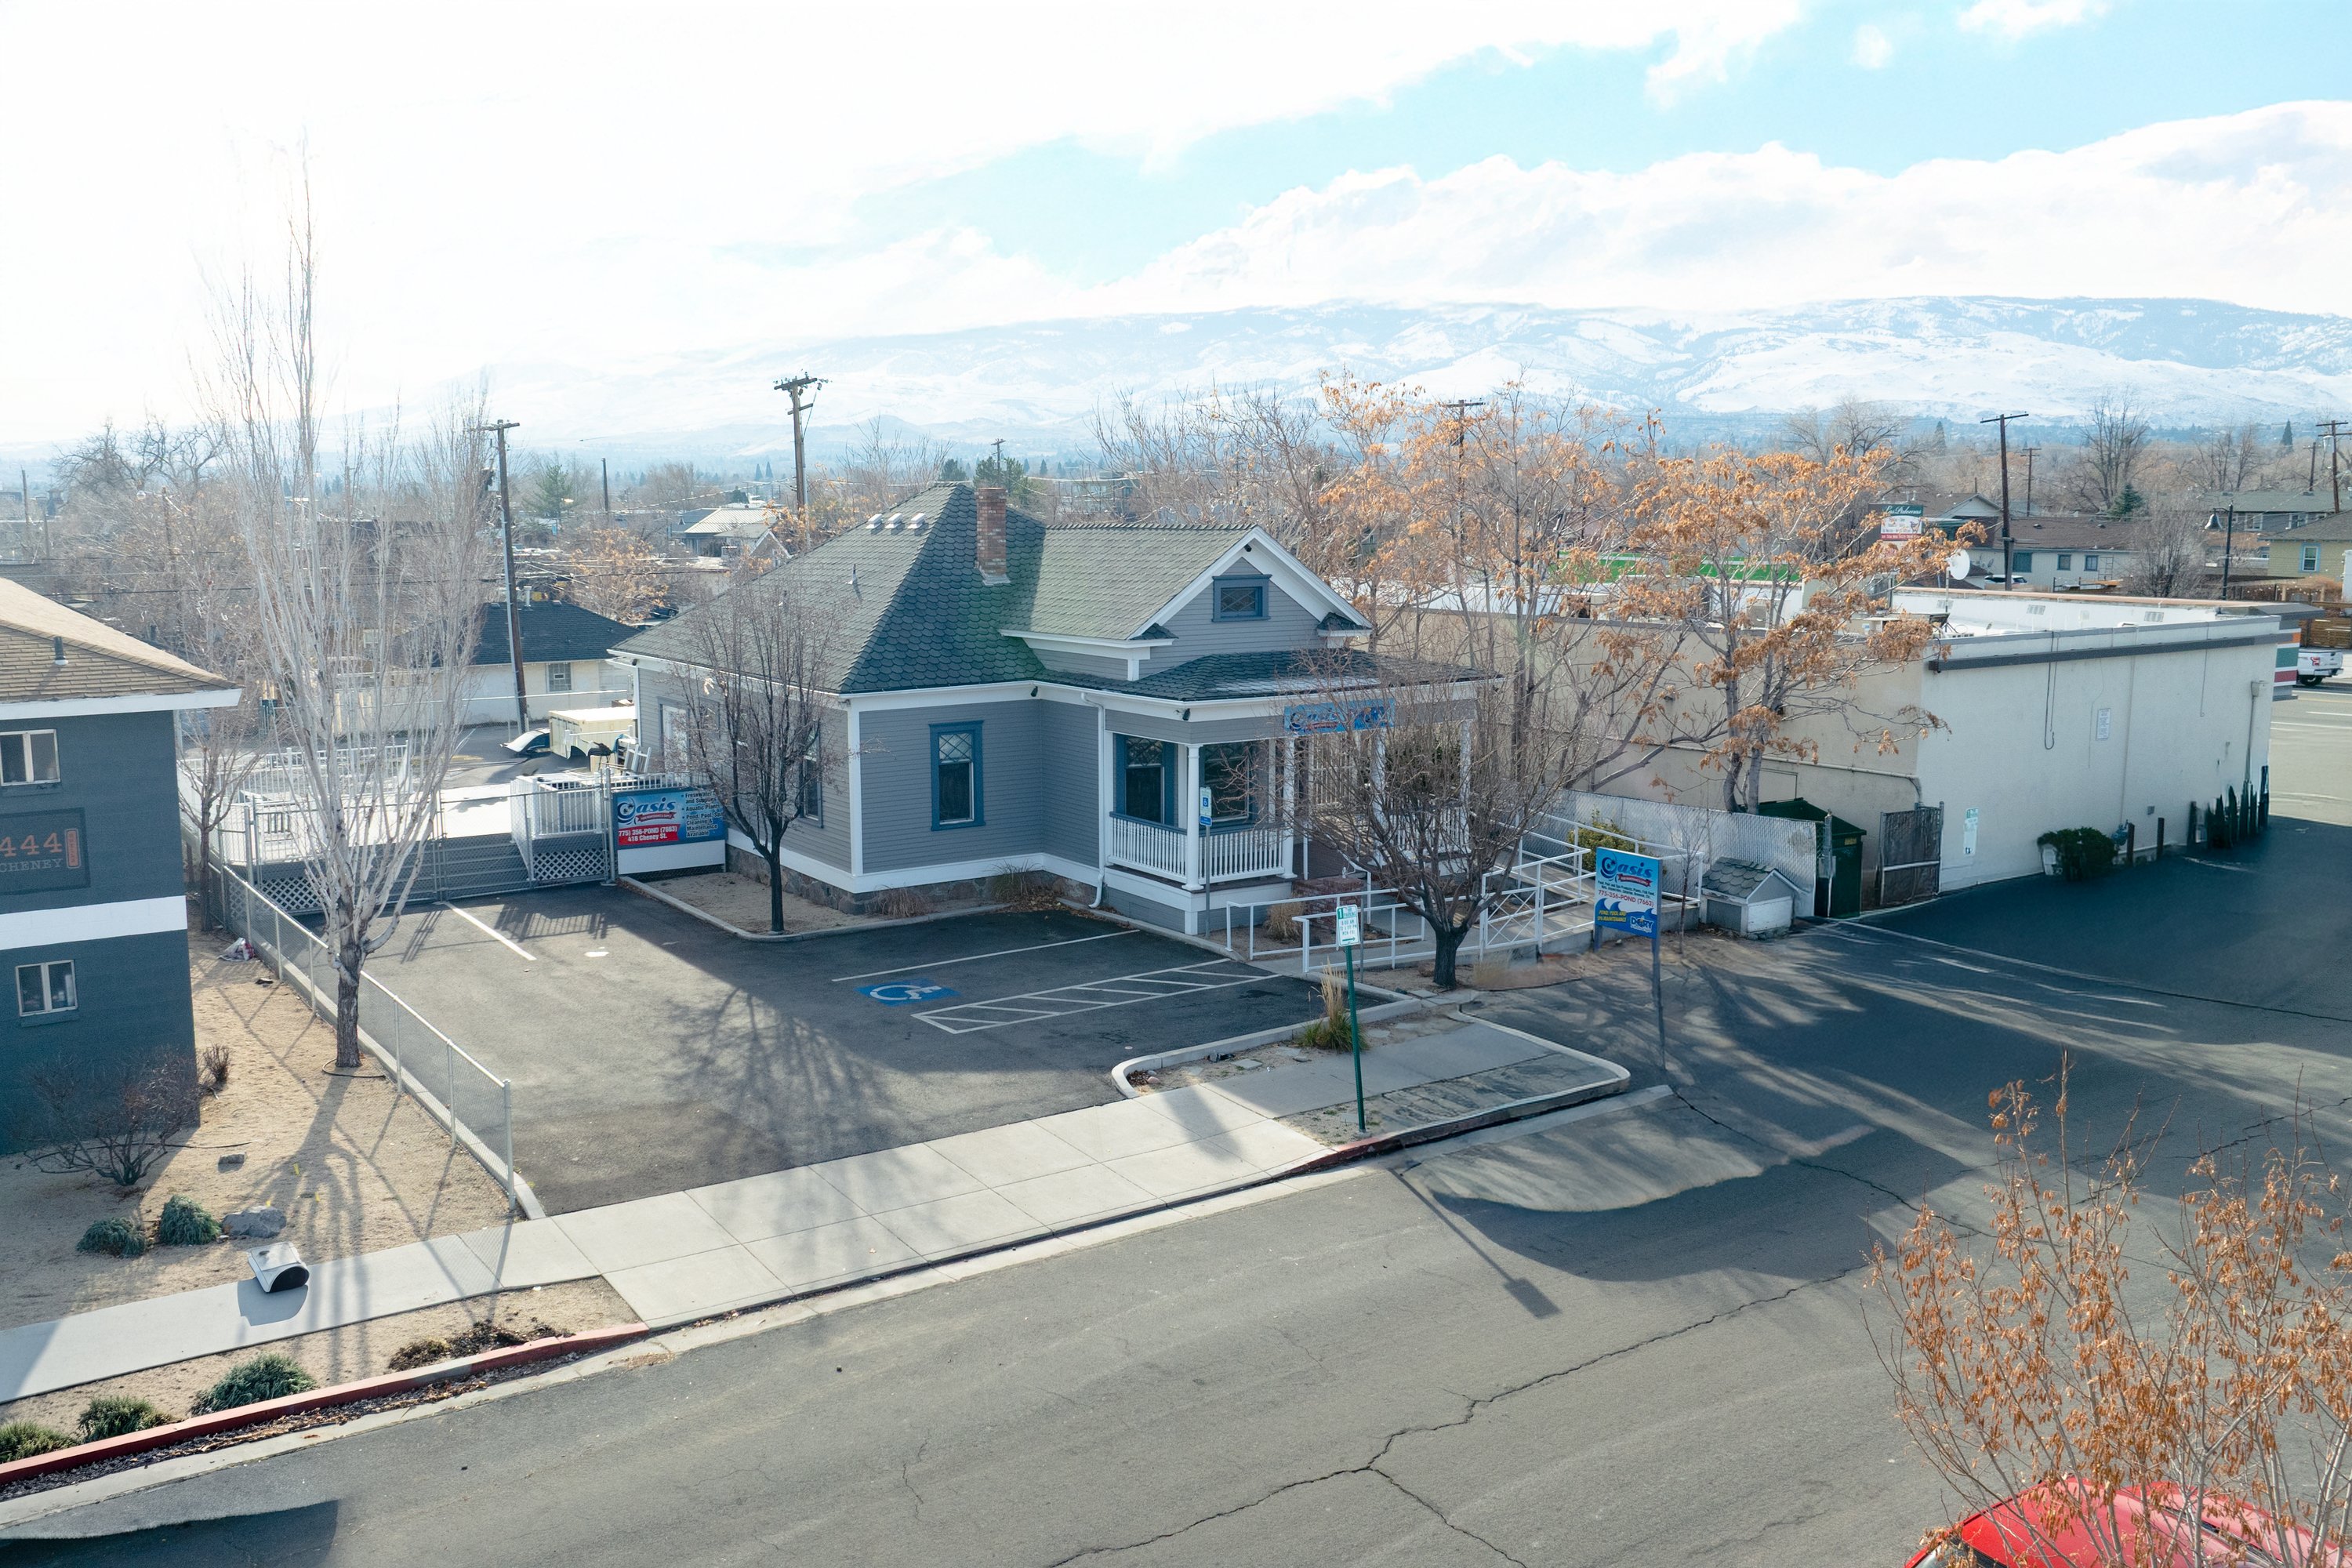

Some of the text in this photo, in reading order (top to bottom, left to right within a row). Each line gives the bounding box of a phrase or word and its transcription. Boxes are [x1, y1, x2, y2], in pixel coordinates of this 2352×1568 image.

[618, 796, 677, 824] Oasis
[0, 832, 63, 857] 444
[0, 858, 64, 873] CHENEY
[1600, 855, 1653, 880] Oasis
[1599, 889, 1636, 902] 775-356-POND
[1637, 898, 1654, 908] (7663)
